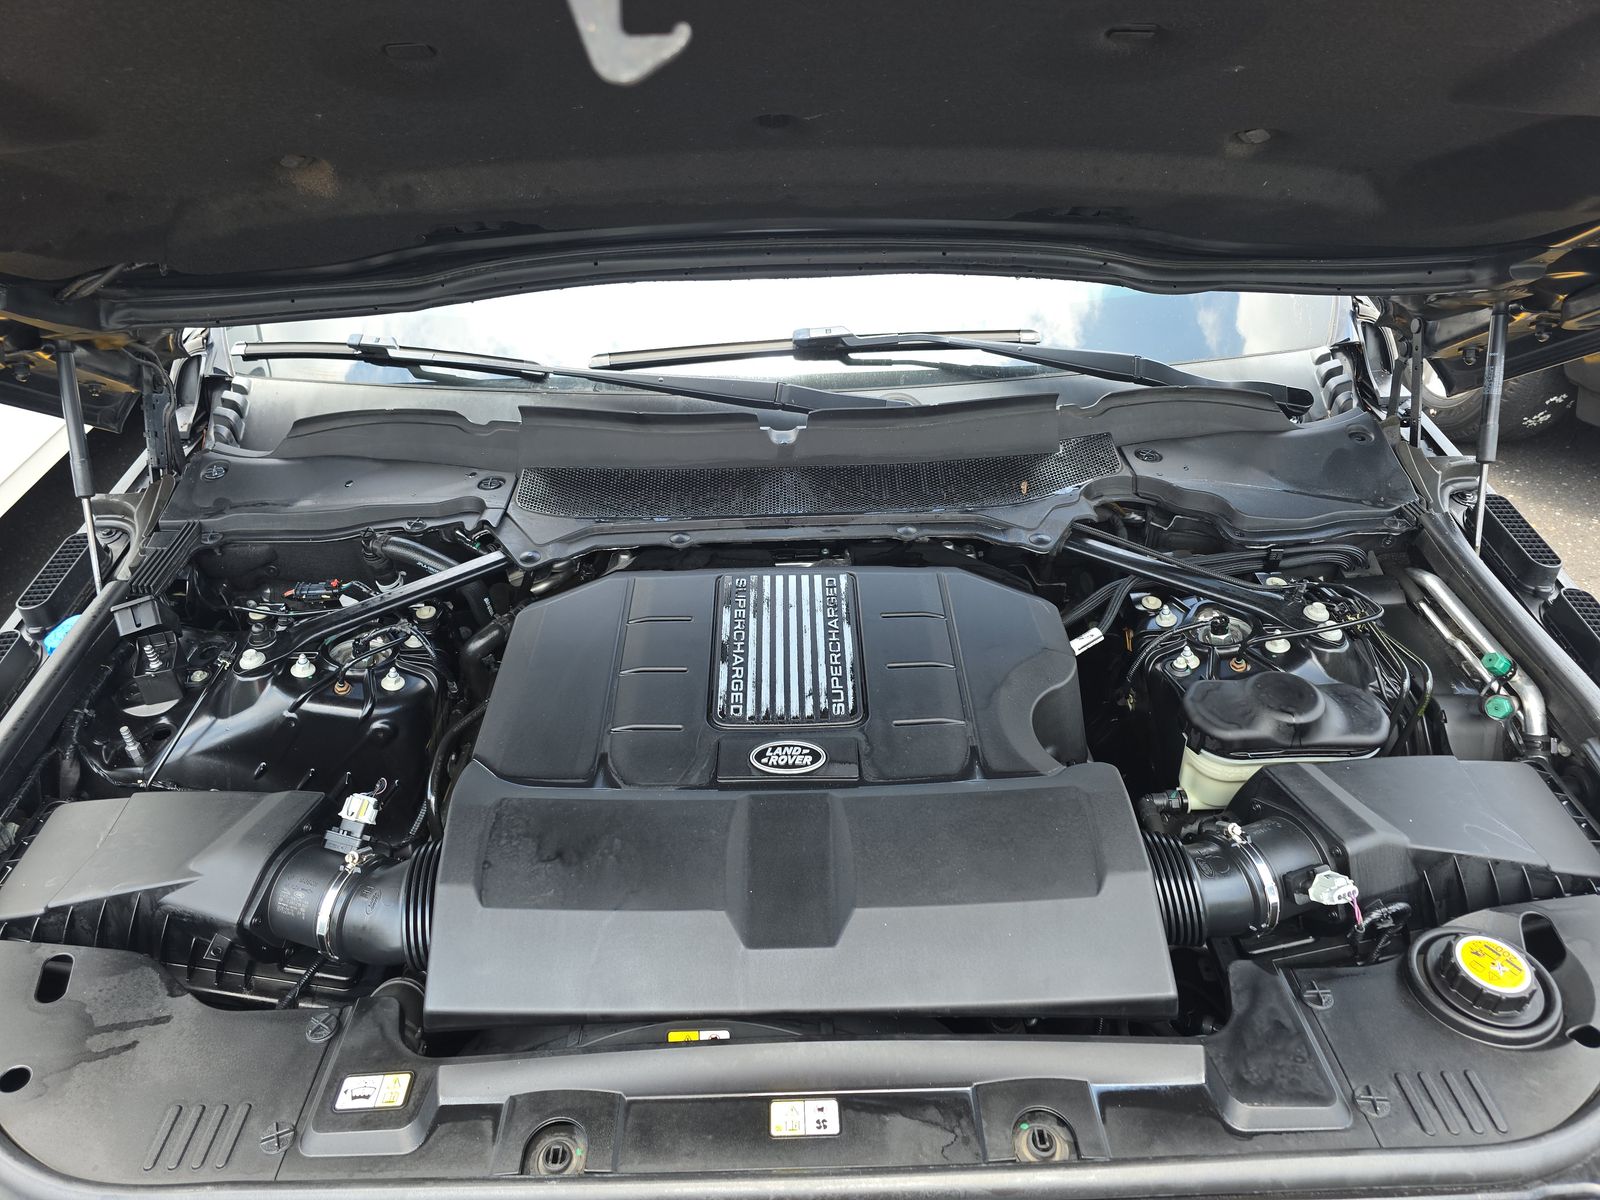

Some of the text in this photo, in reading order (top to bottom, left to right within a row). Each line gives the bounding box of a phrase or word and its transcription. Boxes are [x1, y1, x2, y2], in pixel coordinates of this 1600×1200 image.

[730, 578, 747, 717] SUPERCHARGED
[825, 577, 845, 716] SUPERCHARGED
[766, 746, 801, 757] LAND
[769, 755, 812, 766] ROVER
